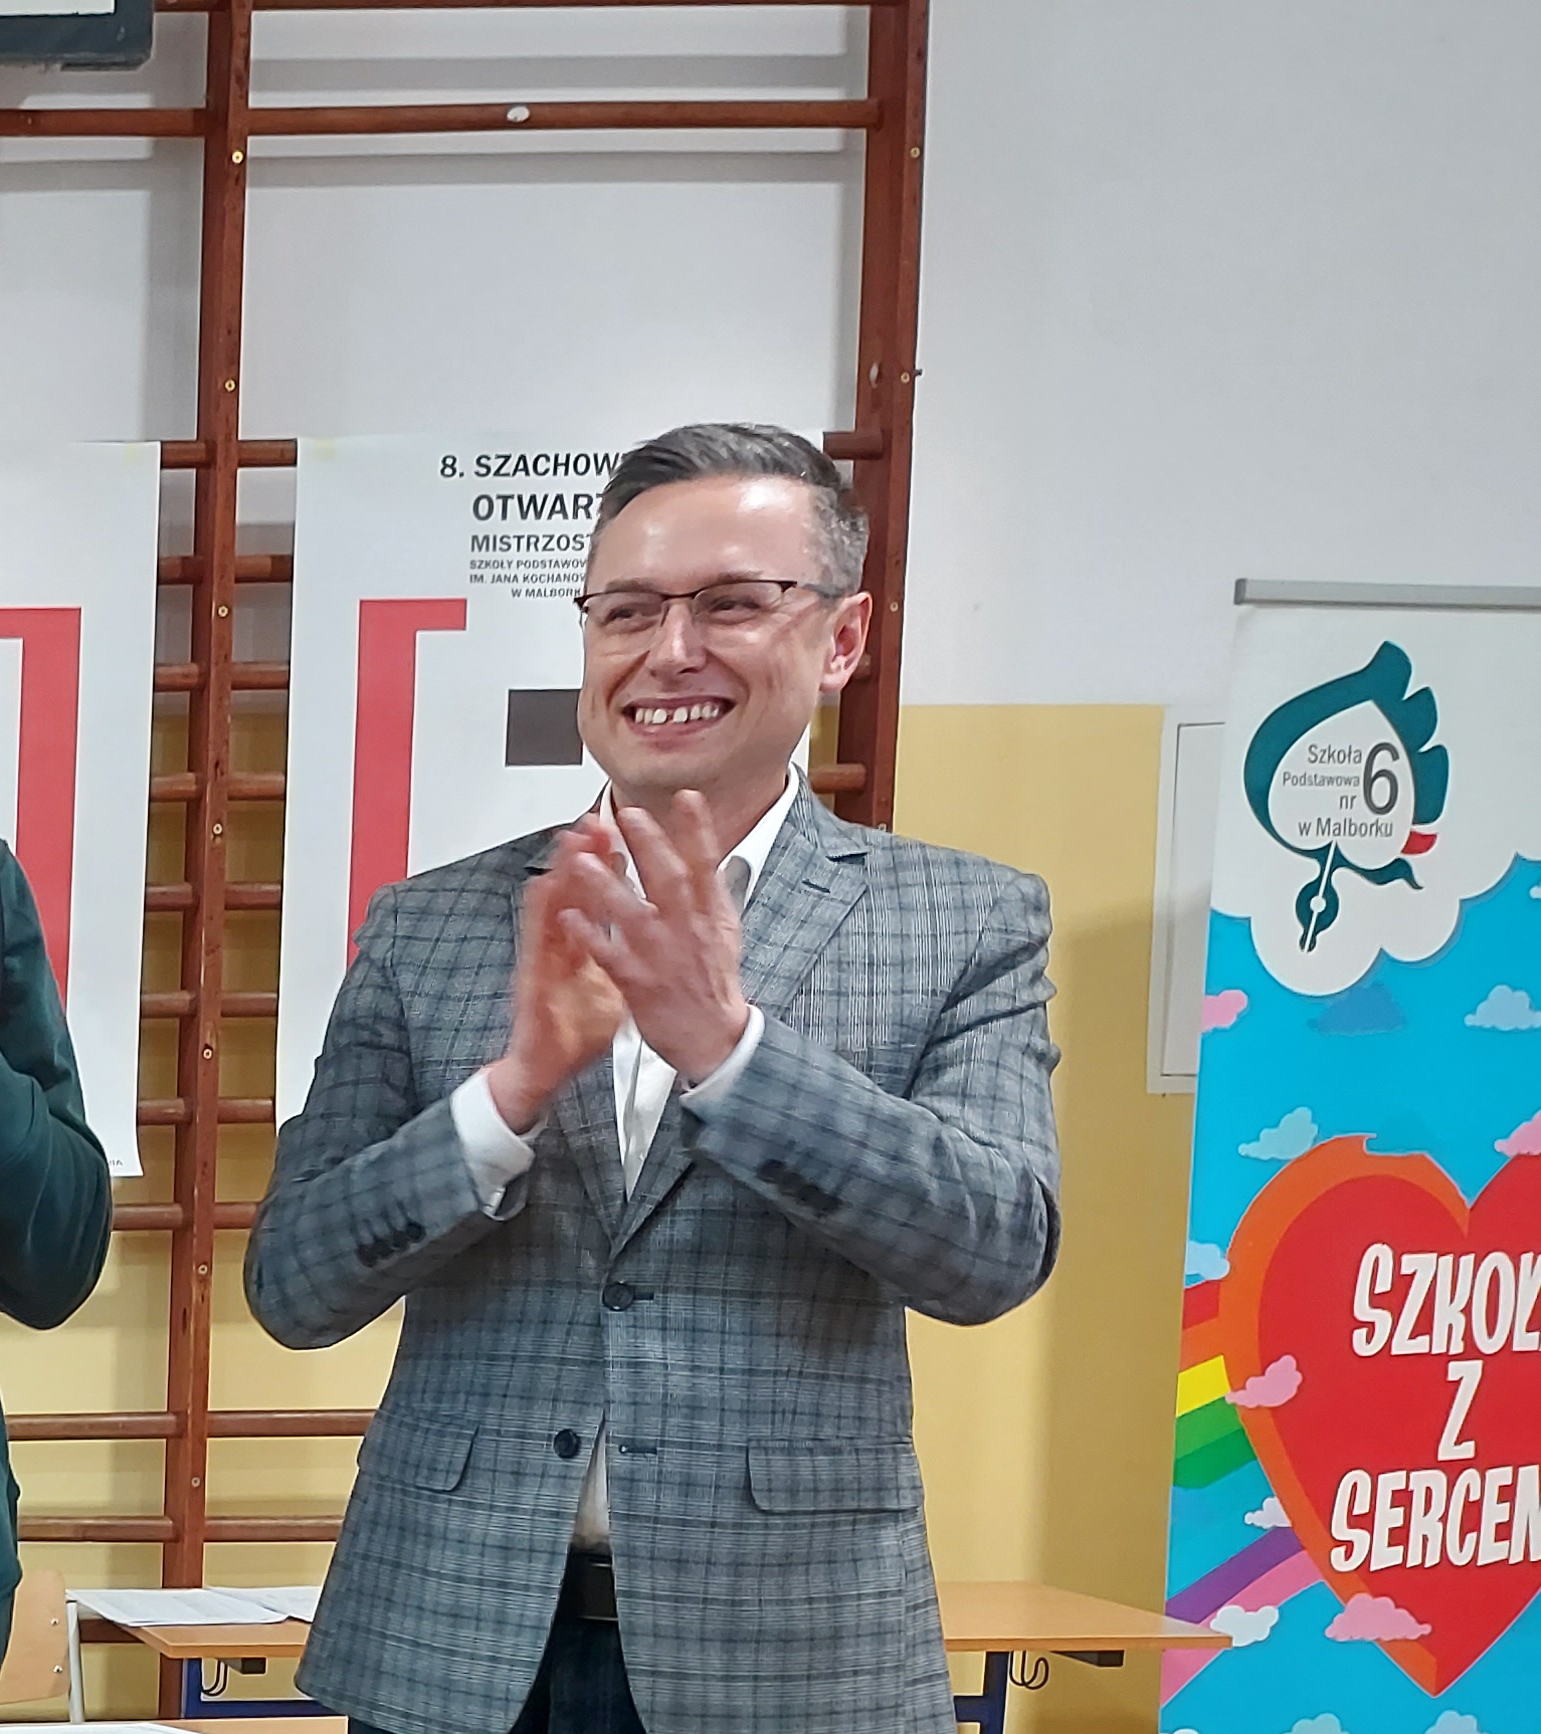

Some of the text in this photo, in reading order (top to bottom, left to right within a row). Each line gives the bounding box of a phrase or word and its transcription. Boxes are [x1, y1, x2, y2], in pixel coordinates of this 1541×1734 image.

[440, 455, 464, 478] 8.
[491, 573, 519, 584] JANA
[511, 588, 522, 598] W
[1307, 743, 1362, 764] Szkoła
[1283, 771, 1360, 787] Podstawowa
[1340, 742, 1400, 815] nr 6
[1298, 817, 1394, 838] w Malborku
[1437, 1359, 1483, 1461] Z
